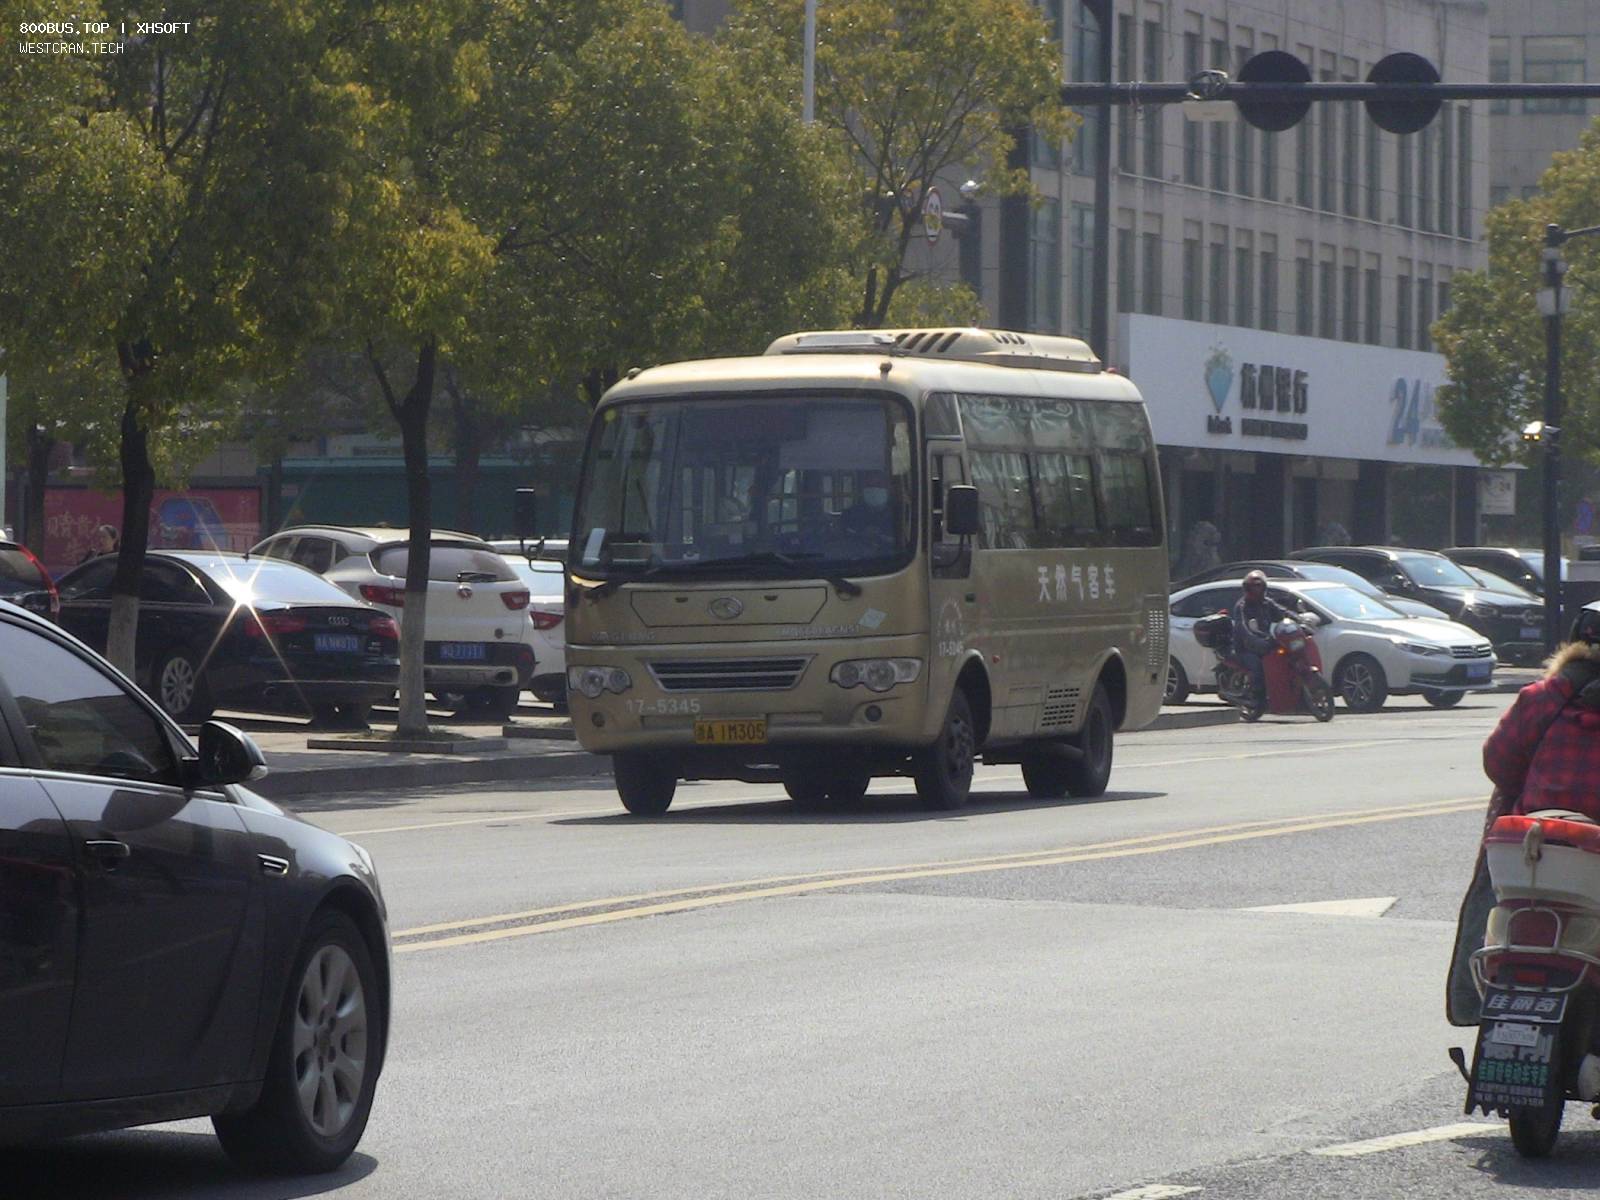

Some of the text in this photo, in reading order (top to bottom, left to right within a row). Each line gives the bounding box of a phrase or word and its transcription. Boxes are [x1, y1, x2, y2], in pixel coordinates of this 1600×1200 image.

[1038, 564, 1116, 601] 天然气客车
[625, 697, 701, 714] 17-5345
